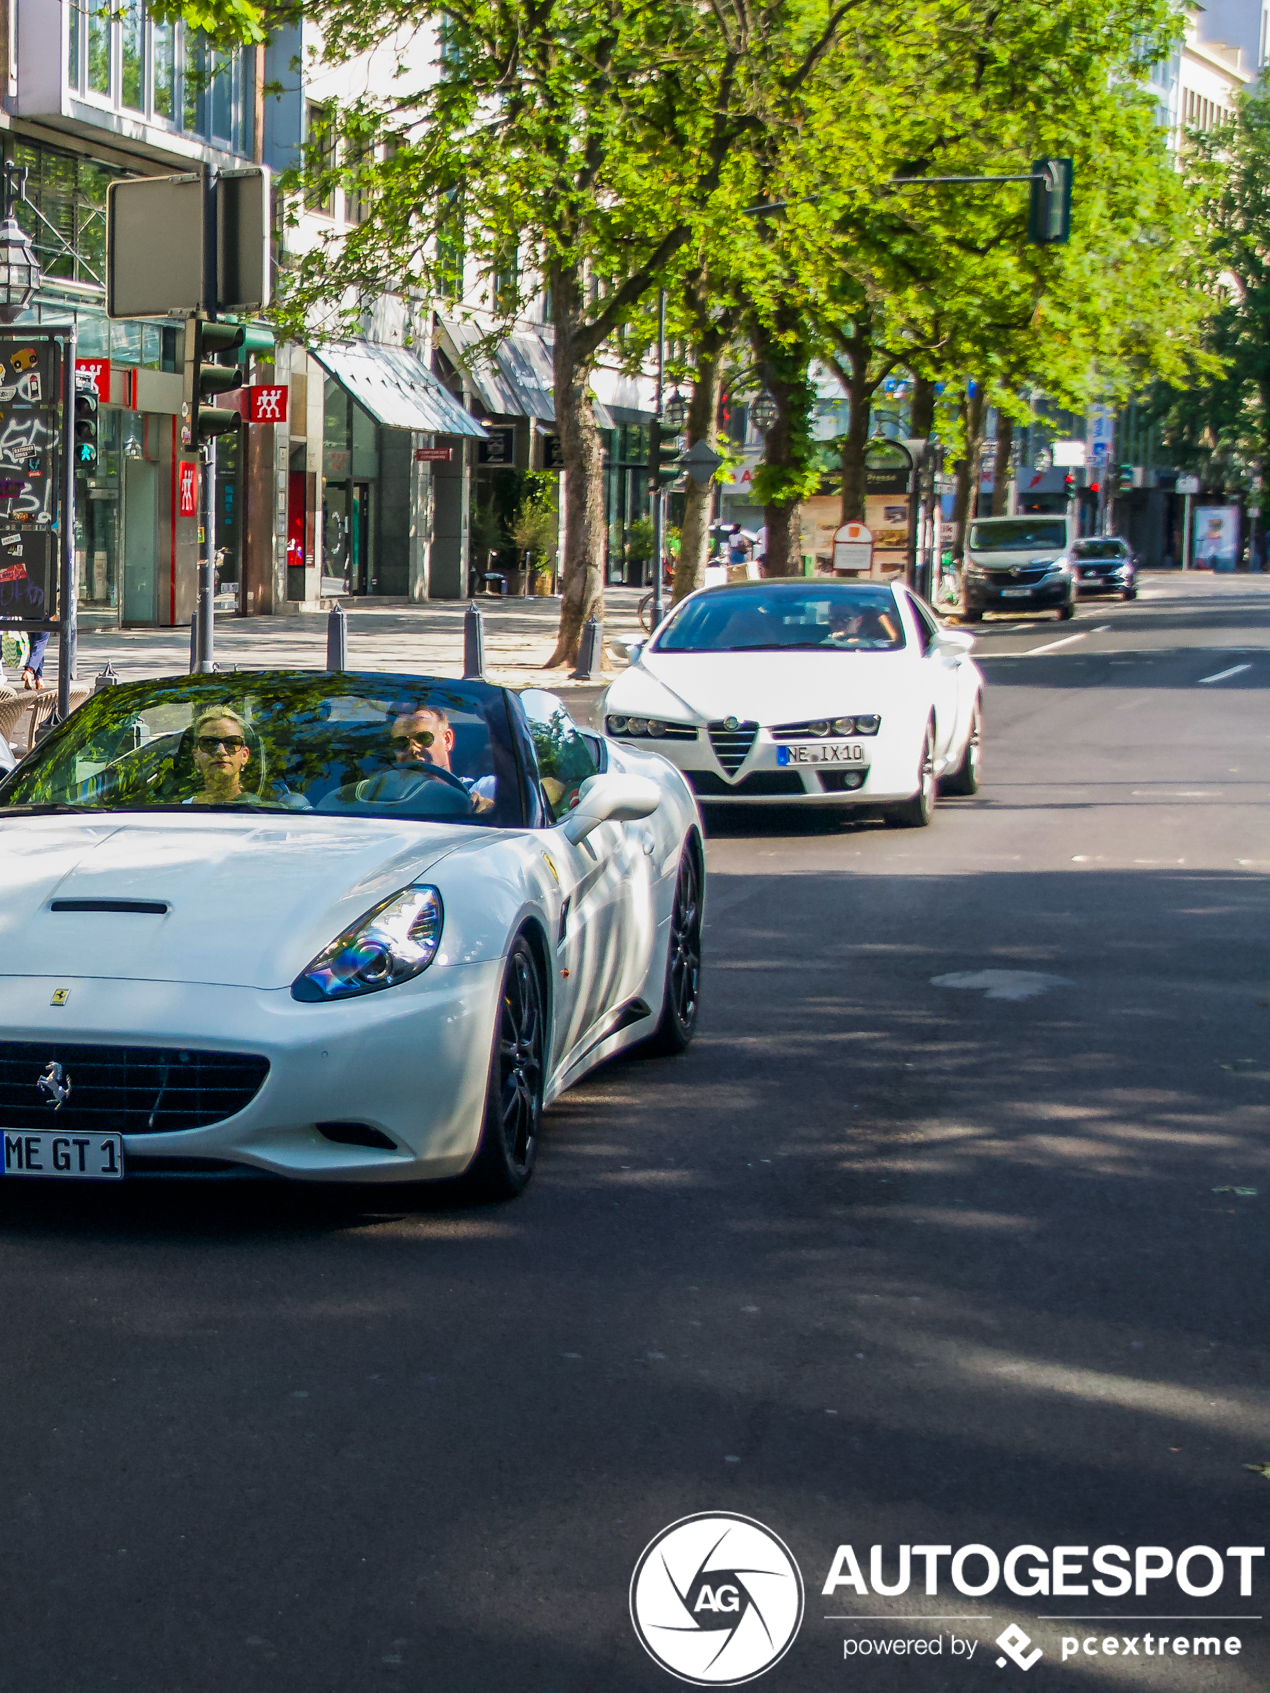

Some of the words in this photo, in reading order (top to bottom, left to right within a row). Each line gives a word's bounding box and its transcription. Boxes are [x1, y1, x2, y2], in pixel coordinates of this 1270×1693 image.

[788, 746, 808, 762] NE
[4, 1134, 43, 1170] ME
[52, 1137, 90, 1171] GT
[100, 1139, 119, 1173] 1
